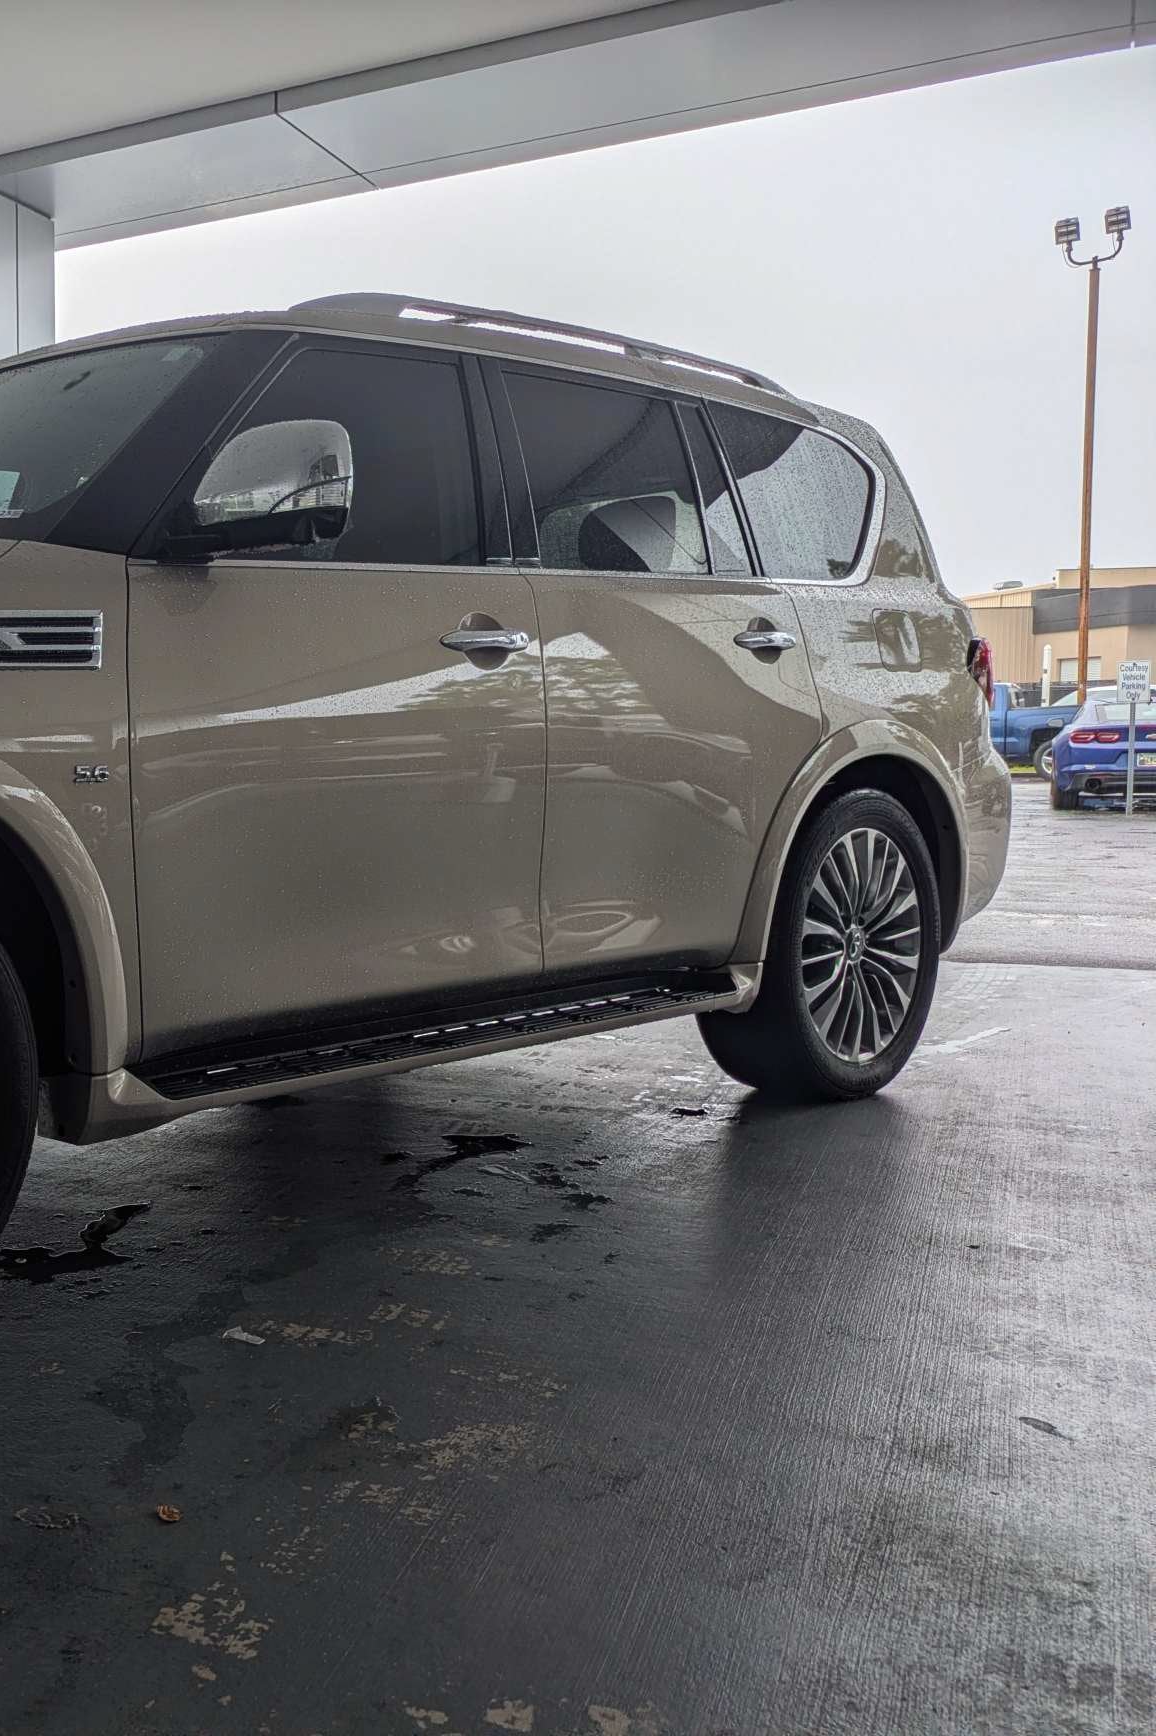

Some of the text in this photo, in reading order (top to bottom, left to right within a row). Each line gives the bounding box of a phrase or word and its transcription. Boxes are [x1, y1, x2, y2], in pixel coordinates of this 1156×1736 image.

[1119, 664, 1148, 673] Courtesy
[1123, 673, 1146, 681] Vehicle
[1121, 682, 1146, 691] Parking
[1125, 691, 1141, 700] Only
